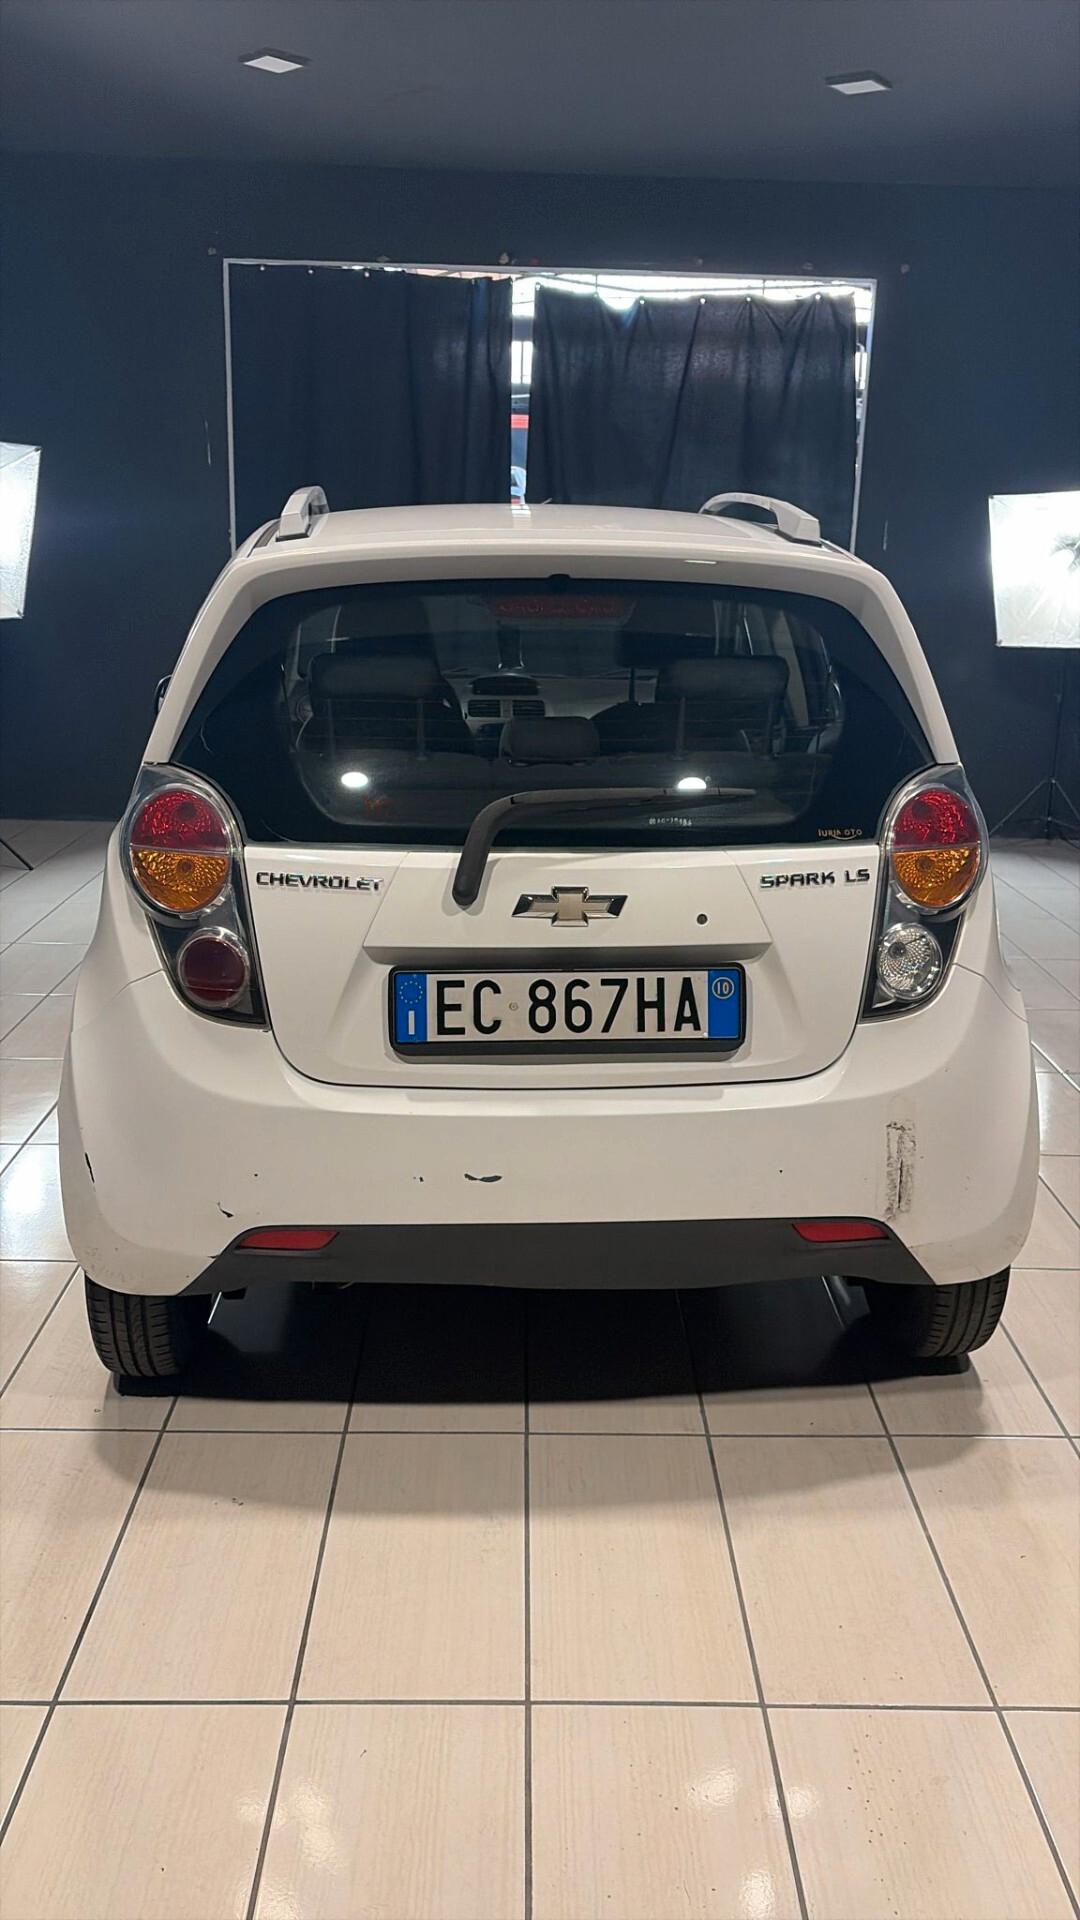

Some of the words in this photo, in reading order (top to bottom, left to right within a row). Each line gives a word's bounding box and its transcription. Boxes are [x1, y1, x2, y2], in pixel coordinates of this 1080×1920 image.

[256, 872, 384, 890] CHEVROLET
[760, 872, 835, 888] SPARK
[845, 868, 870, 882] LS
[437, 979, 502, 1035] EC
[529, 977, 701, 1034] 867HA
